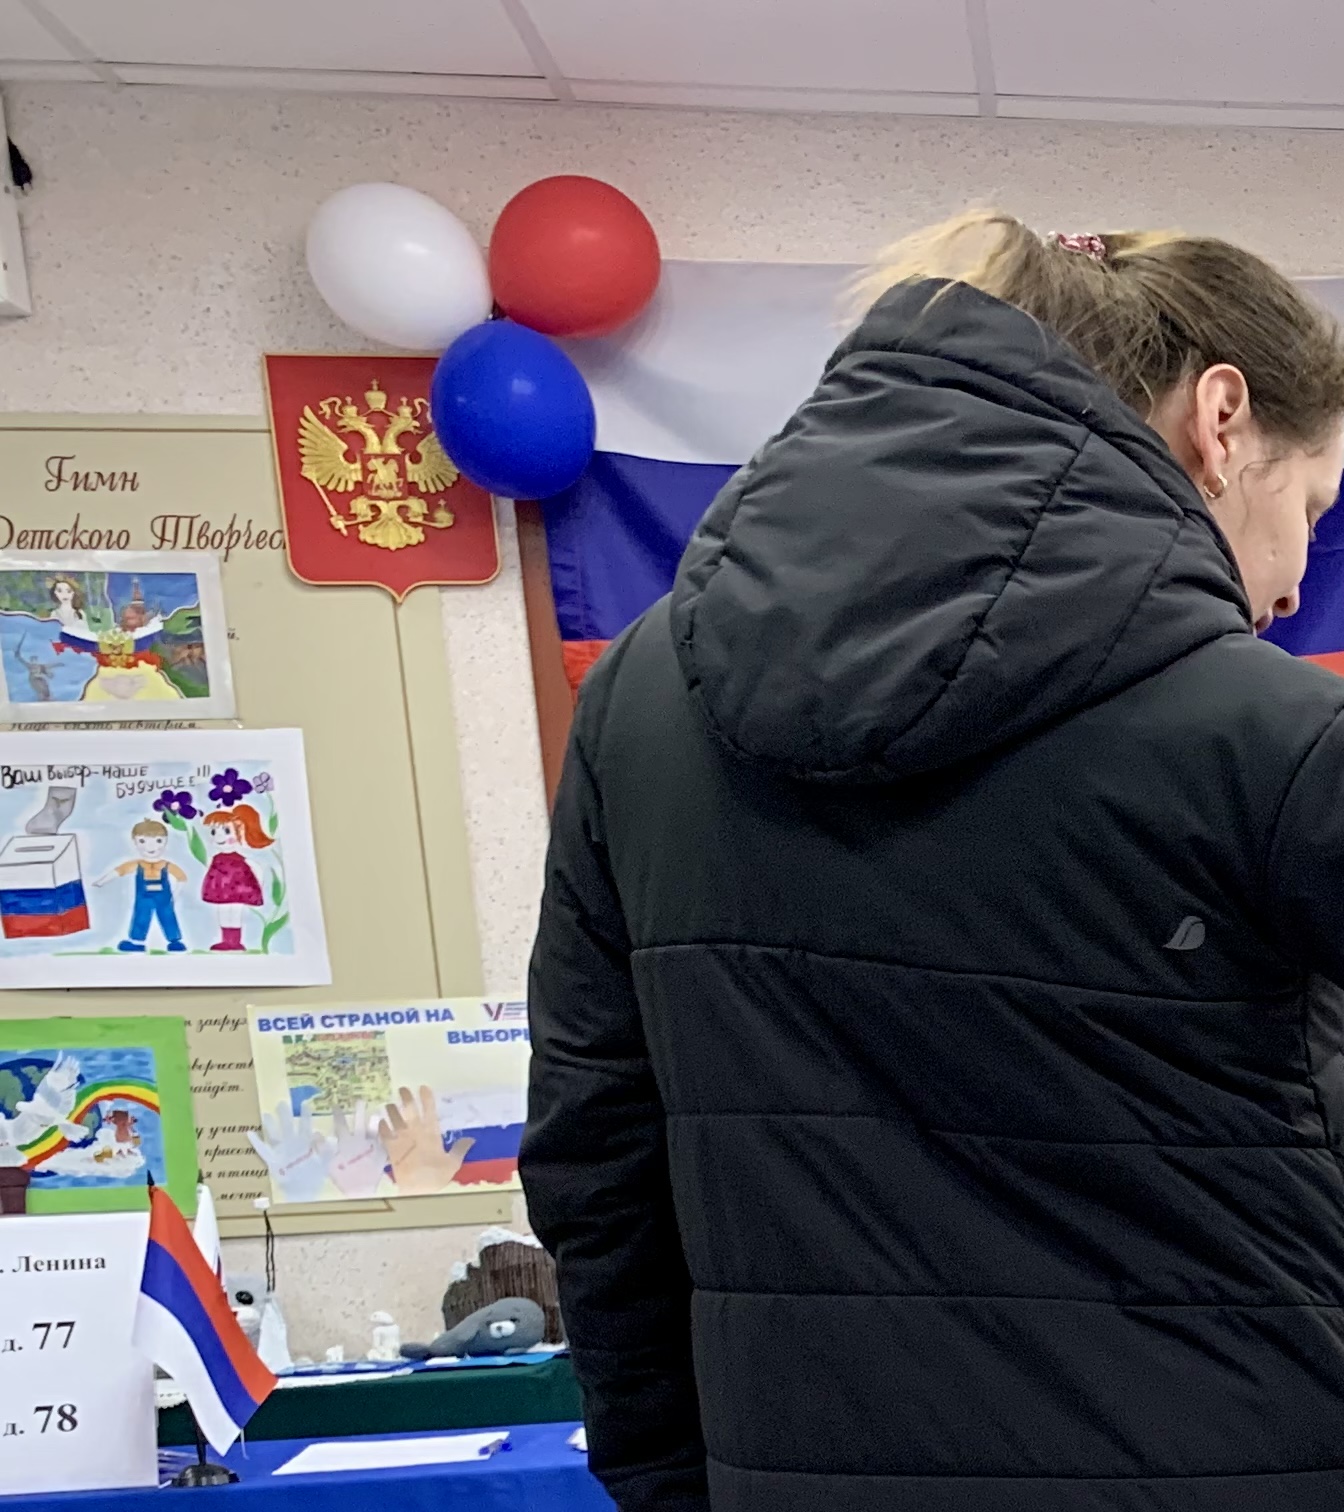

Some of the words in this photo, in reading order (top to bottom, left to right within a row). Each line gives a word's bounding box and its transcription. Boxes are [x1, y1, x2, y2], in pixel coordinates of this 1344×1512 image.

[45, 455, 139, 492] Гимн
[150, 512, 286, 563] Творчес
[258, 1013, 315, 1033] ВСЕЙ
[320, 1007, 420, 1029] СТРАНОЙ
[426, 1008, 455, 1023] НА
[12, 1254, 107, 1273] Ленина
[32, 1321, 76, 1350] 77
[3, 1422, 25, 1437] д.
[33, 1403, 78, 1434] 78
